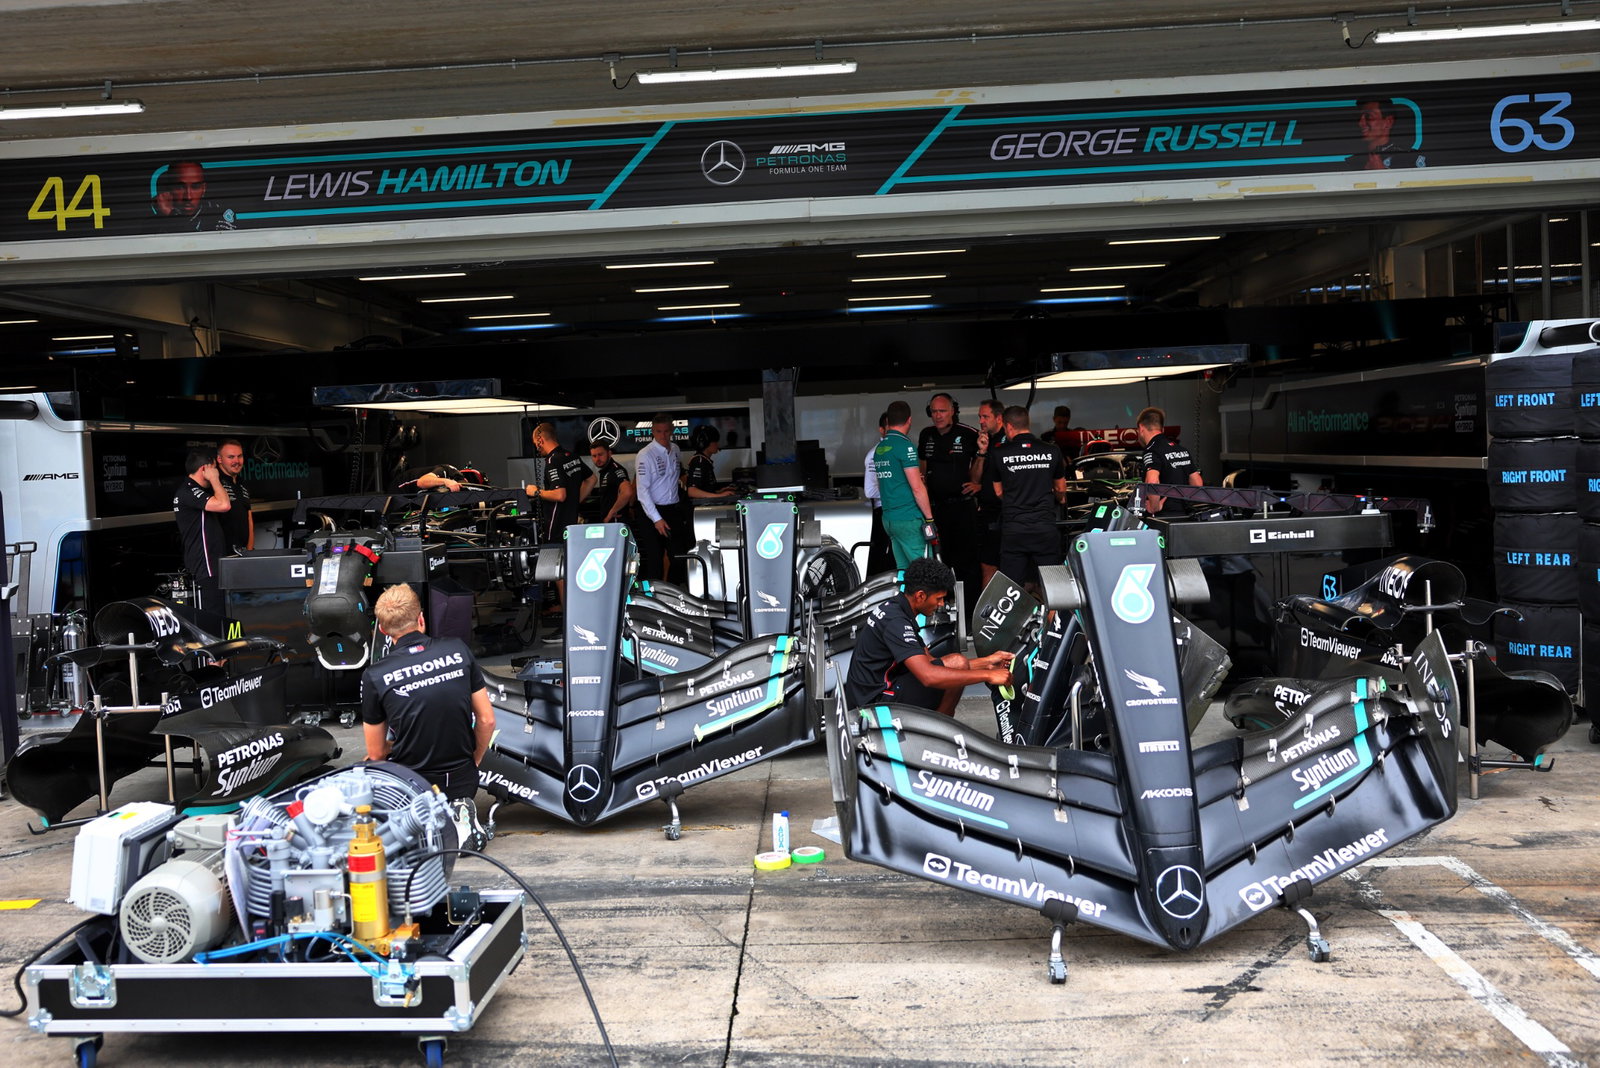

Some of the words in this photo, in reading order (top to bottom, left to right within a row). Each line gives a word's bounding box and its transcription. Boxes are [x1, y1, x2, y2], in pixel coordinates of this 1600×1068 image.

[1489, 91, 1575, 154] 63
[794, 142, 846, 154] AMG
[989, 127, 1140, 161] GEORGE
[1142, 119, 1303, 153] RUSSELL
[756, 152, 848, 168] PETRONAS
[768, 166, 806, 176] FORMULA
[807, 165, 825, 174] ONE
[826, 163, 848, 173] TEAM
[263, 169, 374, 202] LEWIS
[375, 158, 573, 196] HAMILTON
[27, 173, 112, 232] 44
[1494, 394, 1514, 408] LEFT
[1517, 391, 1555, 407] FRONT
[1287, 409, 1299, 433] All
[1299, 410, 1307, 432] in
[1307, 409, 1369, 432] Performance
[1002, 452, 1053, 464] PETRONAS
[41, 472, 80, 480] AMG
[1502, 469, 1528, 484] RIGHT
[1530, 468, 1567, 484] FRONT
[1268, 529, 1315, 541] Einhell
[1506, 551, 1530, 566] LEFT
[1535, 552, 1571, 567] REAR
[1322, 574, 1338, 601] 63
[978, 585, 1022, 642] INEOS
[641, 625, 685, 645] PETRONAS
[1308, 631, 1362, 660] TeamViewer
[639, 641, 679, 667] Syntium
[1508, 641, 1537, 656] RIGHT
[1539, 644, 1573, 659] REAR
[382, 652, 464, 686] PETRONAS
[399, 668, 465, 694] CROWDSTRIKE
[211, 675, 263, 703] TeamViewer
[698, 669, 756, 698] PETRONAS
[705, 685, 764, 718] Syntium
[1125, 697, 1178, 707] CROWDSTRIKE
[217, 733, 284, 769] PETRONAS
[1138, 739, 1180, 753] PIRELLI
[1280, 725, 1341, 763] PETRONAS
[211, 752, 283, 798] Syntium
[921, 749, 1001, 781] PETRONAS
[1291, 747, 1359, 793] Syntium
[912, 769, 995, 812] Syntium
[1140, 787, 1194, 800] AKKODIS
